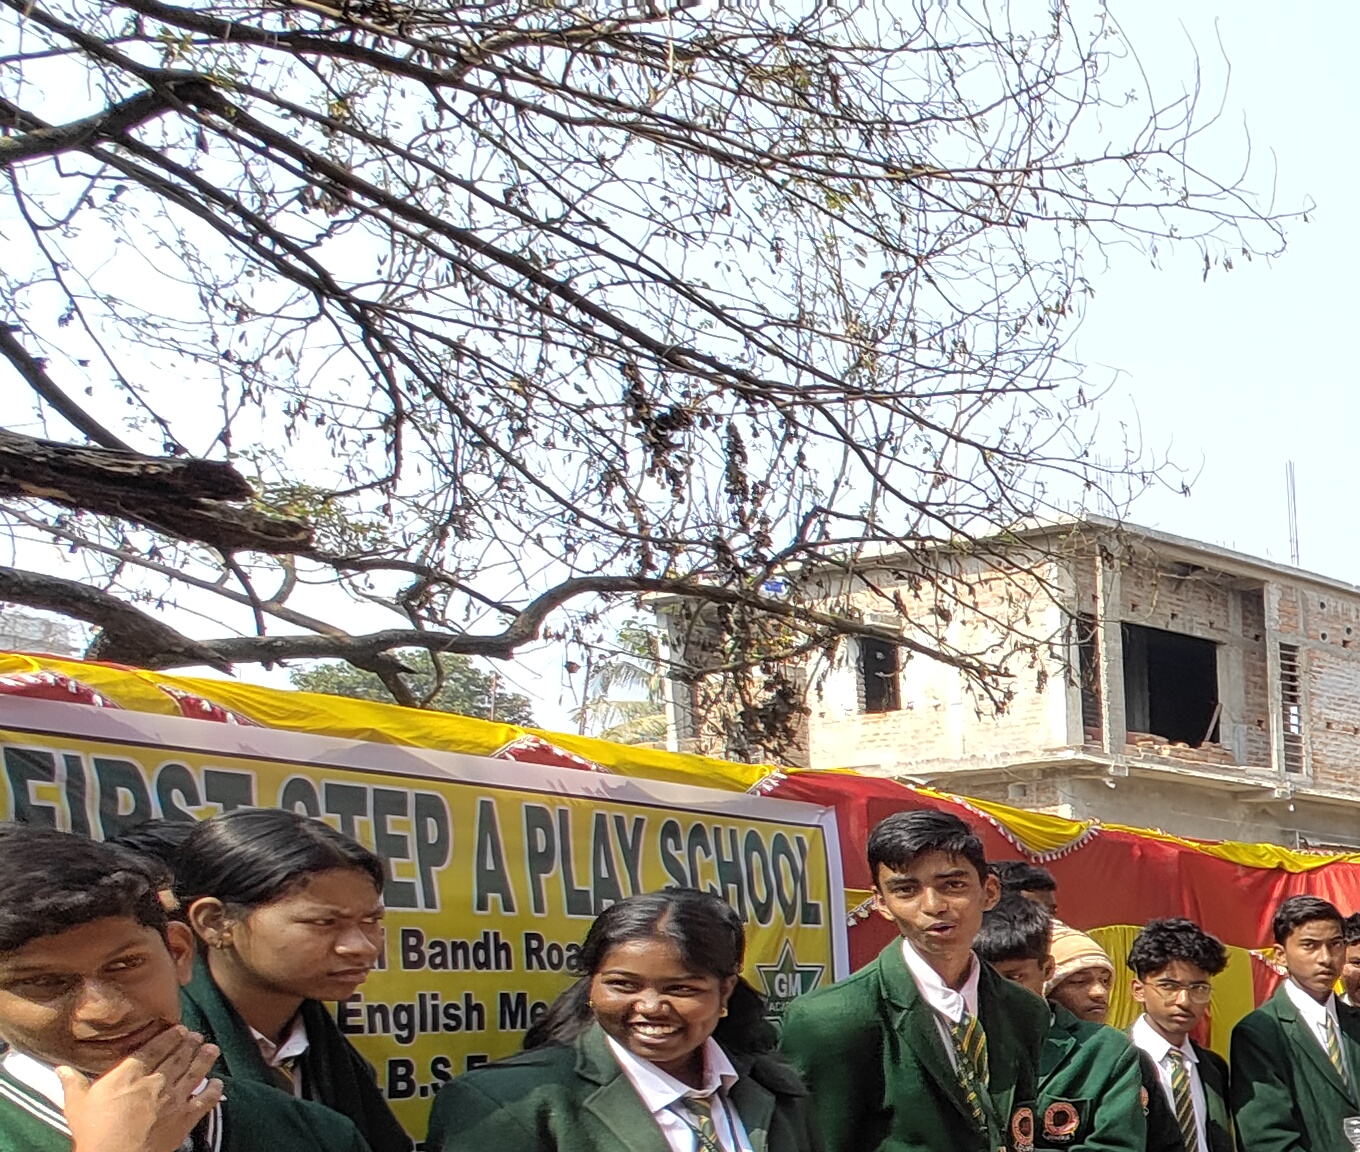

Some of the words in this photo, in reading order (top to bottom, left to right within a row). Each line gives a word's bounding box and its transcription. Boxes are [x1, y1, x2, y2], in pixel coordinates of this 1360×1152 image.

[3, 746, 254, 841] FIR
[475, 800, 515, 913] A
[525, 805, 647, 917] PLAY
[659, 819, 822, 926] SCHOOL
[402, 929, 512, 971] Bandh
[524, 932, 584, 971] Roa
[775, 973, 802, 998] GM
[338, 994, 485, 1044] English
